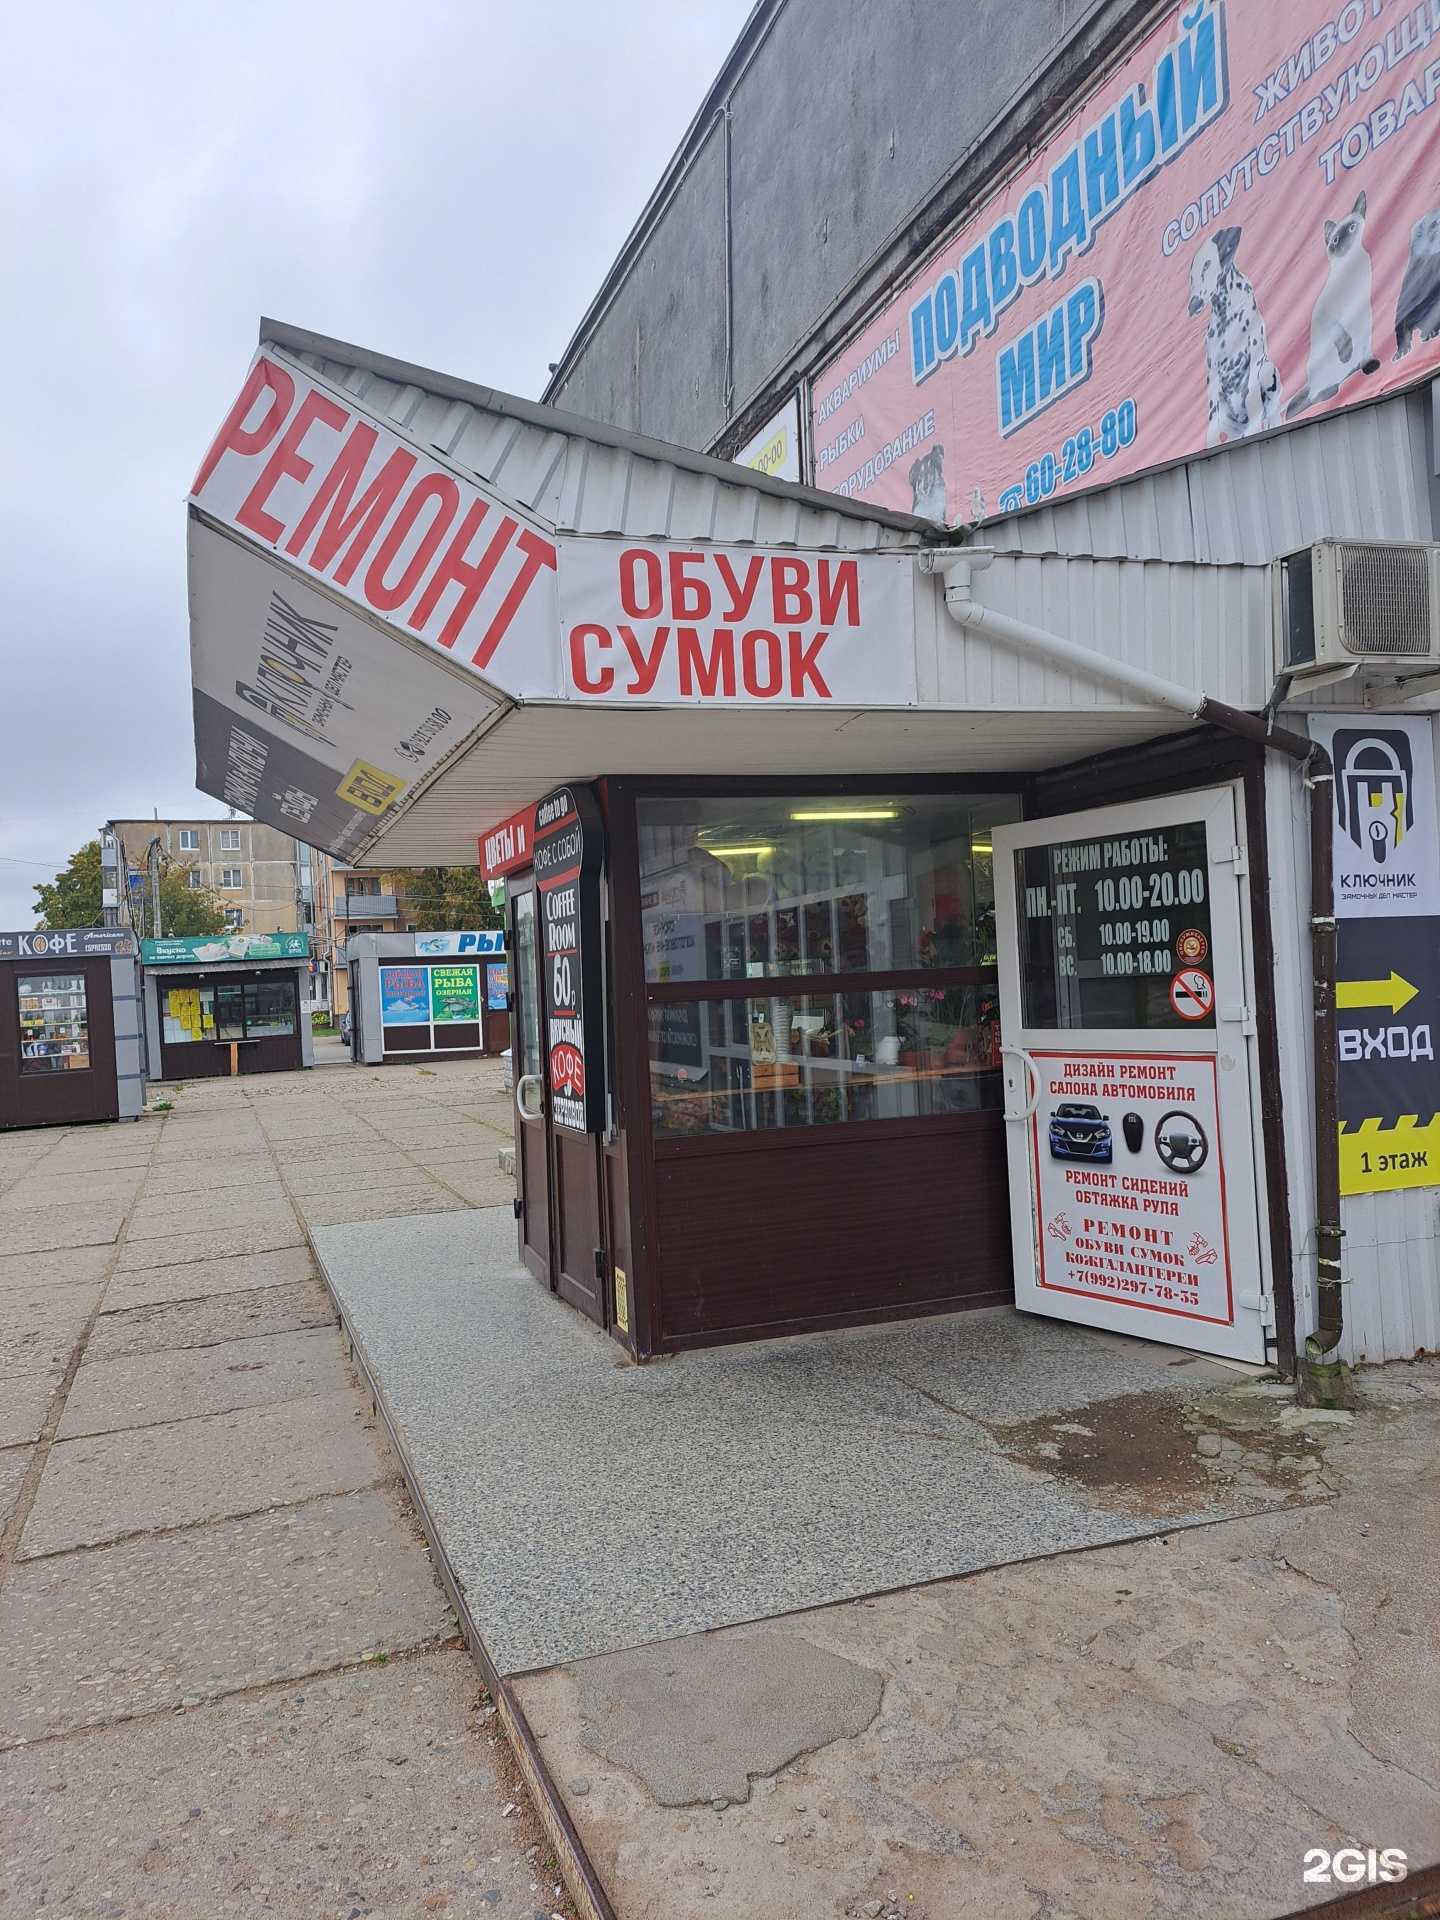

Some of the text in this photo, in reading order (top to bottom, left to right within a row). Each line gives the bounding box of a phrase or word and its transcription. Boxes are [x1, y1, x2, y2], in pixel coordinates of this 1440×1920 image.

[908, 0, 1228, 385] ПОДВОДНЫЙ
[998, 279, 1103, 438] МИР
[818, 329, 900, 424] АКВАРИУМЫ
[819, 414, 865, 472] РЫБКИ
[1025, 397, 1137, 506] 60-28-80
[191, 358, 557, 670] РЕМОНТ
[619, 548, 861, 627] ОБУВИ
[570, 623, 832, 699] СУМОК
[271, 784, 319, 824] СЕЙФЫ
[485, 824, 525, 872] ЦВЕТЫ И
[534, 826, 580, 871] КОФЕ С СОБОЙ
[1054, 835, 1168, 873] РЕЖИМ РАБОТЫ:
[1026, 868, 1204, 918] ПН.-ПТ. 10.00-20.00
[1341, 873, 1416, 888] КЛЮЧНИК
[546, 888, 575, 921] COFFEE
[18, 933, 78, 955] КОФЕ
[548, 921, 576, 951] ROOM
[1057, 919, 1170, 948] СБ. 10.00-19.00
[433, 968, 473, 976] СВЕЖАЯ
[1058, 949, 1171, 977] ВС. 10.00-18.00
[434, 977, 473, 988] РЫБА
[1338, 1024, 1434, 1062] ВХОД
[552, 1050, 583, 1087] КОФЕ
[1063, 1062, 1176, 1081] ДИЗАЙН РЕМОНТ
[1050, 1080, 1196, 1101] САЛОНА АВТОМОБИЛЯ
[1361, 1148, 1428, 1172] 1 этаж
[1066, 1170, 1188, 1198] РЕМОНТ СИДЕНИЙ
[1075, 1190, 1180, 1217] ОБТЯЖКА РУЛЯ
[1083, 1218, 1174, 1246] РЕМОНТ
[1075, 1237, 1185, 1267] ОБУВИ СУМОК
